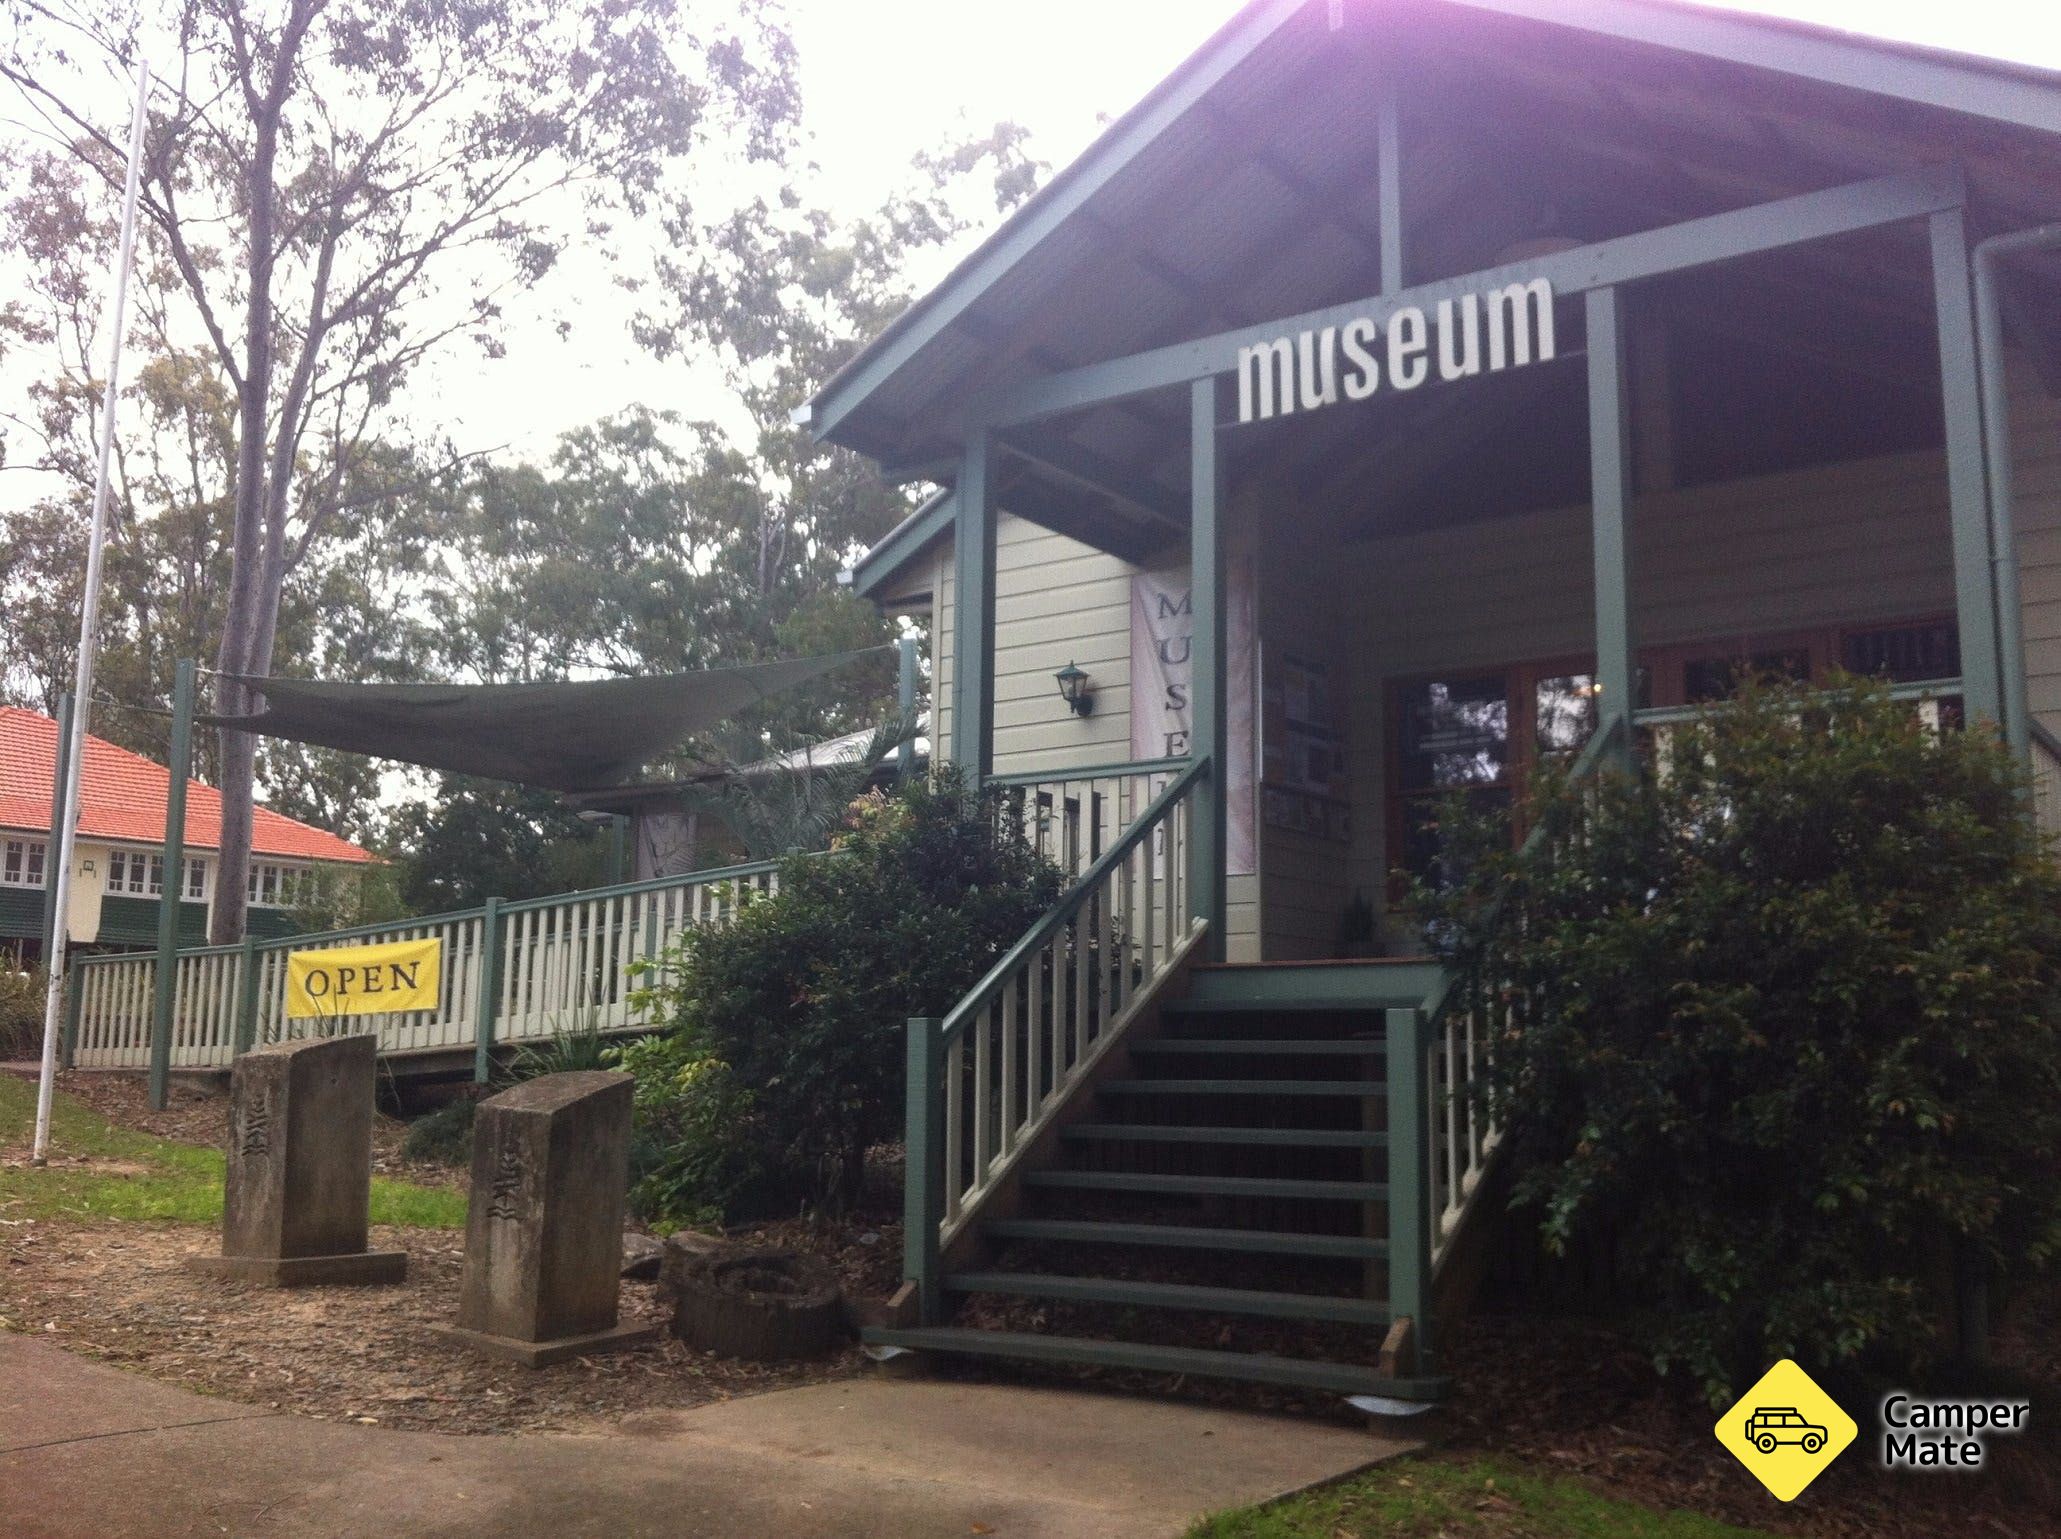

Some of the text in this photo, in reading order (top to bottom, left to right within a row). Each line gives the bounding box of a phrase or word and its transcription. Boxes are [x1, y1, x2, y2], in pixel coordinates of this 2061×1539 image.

[1237, 277, 1555, 423] museum
[1157, 588, 1193, 856] MUSE
[305, 961, 420, 997] OPEN
